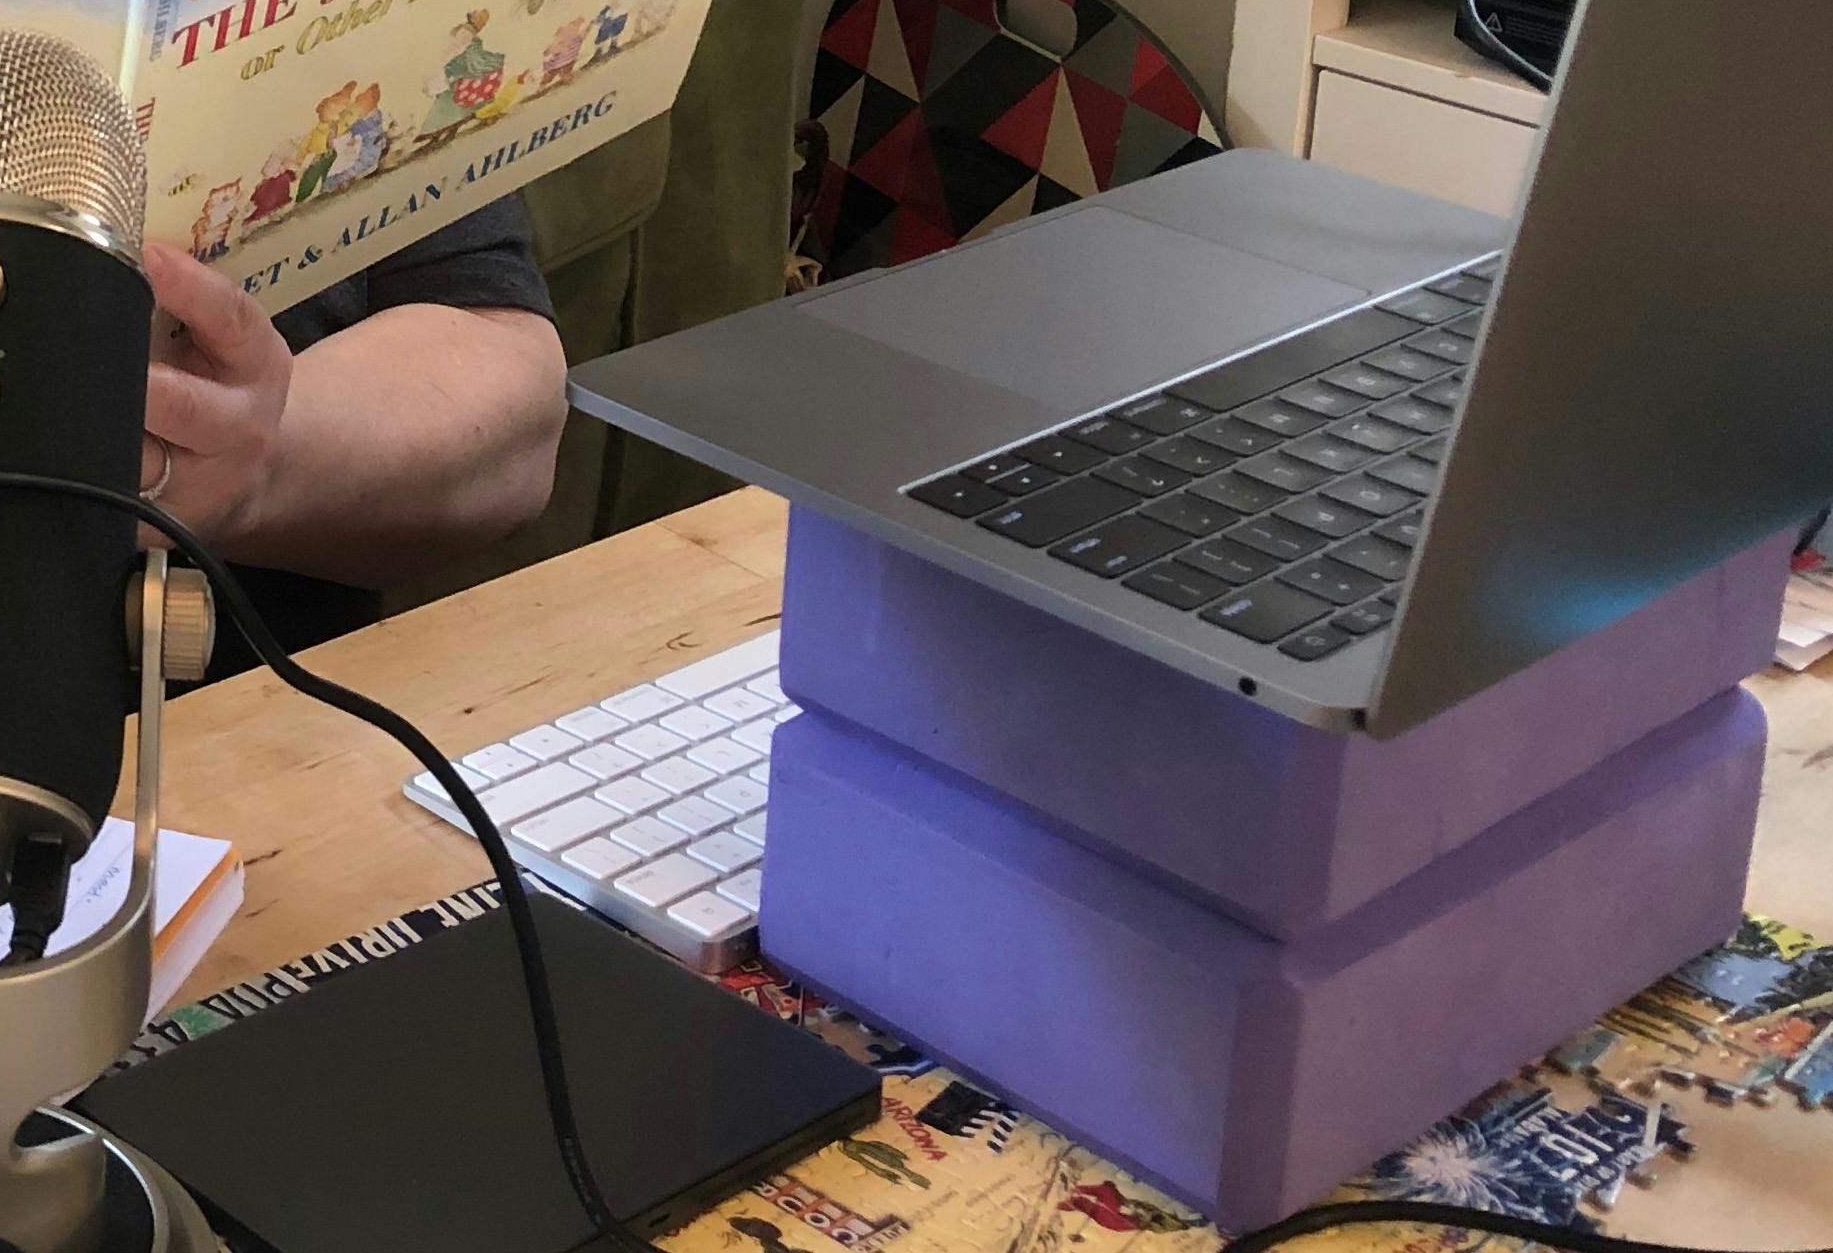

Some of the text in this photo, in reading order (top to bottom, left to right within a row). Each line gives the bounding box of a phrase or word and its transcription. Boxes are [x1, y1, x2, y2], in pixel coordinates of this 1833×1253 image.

[240, 45, 285, 81] or
[297, 244, 324, 270] &
[332, 175, 449, 255] ALLAN
[455, 89, 618, 191] AHLBERG
[882, 1096, 949, 1162] ARIZONA
